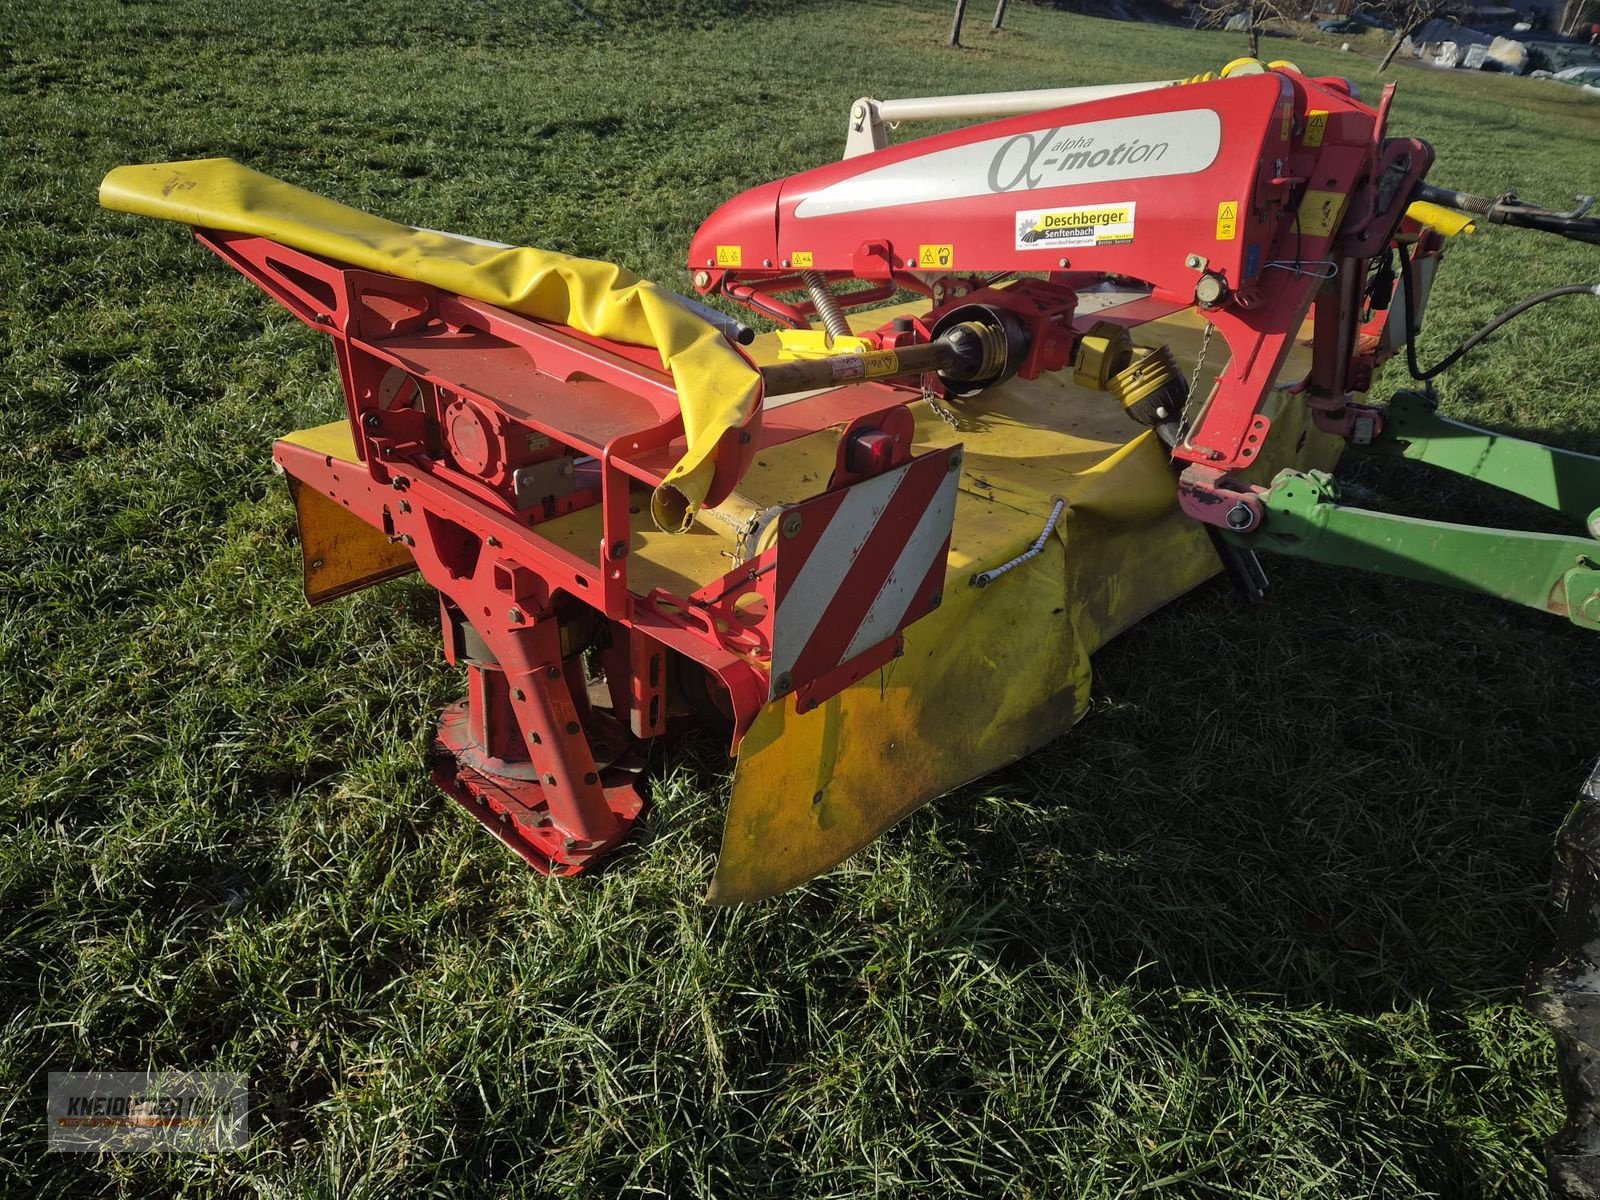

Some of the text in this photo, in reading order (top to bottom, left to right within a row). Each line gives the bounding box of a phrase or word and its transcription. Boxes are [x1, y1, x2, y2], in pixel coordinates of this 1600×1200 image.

[1051, 136, 1095, 152] alpha
[1045, 212, 1124, 227] Deschberger
[1045, 227, 1094, 238] Senftenbach
